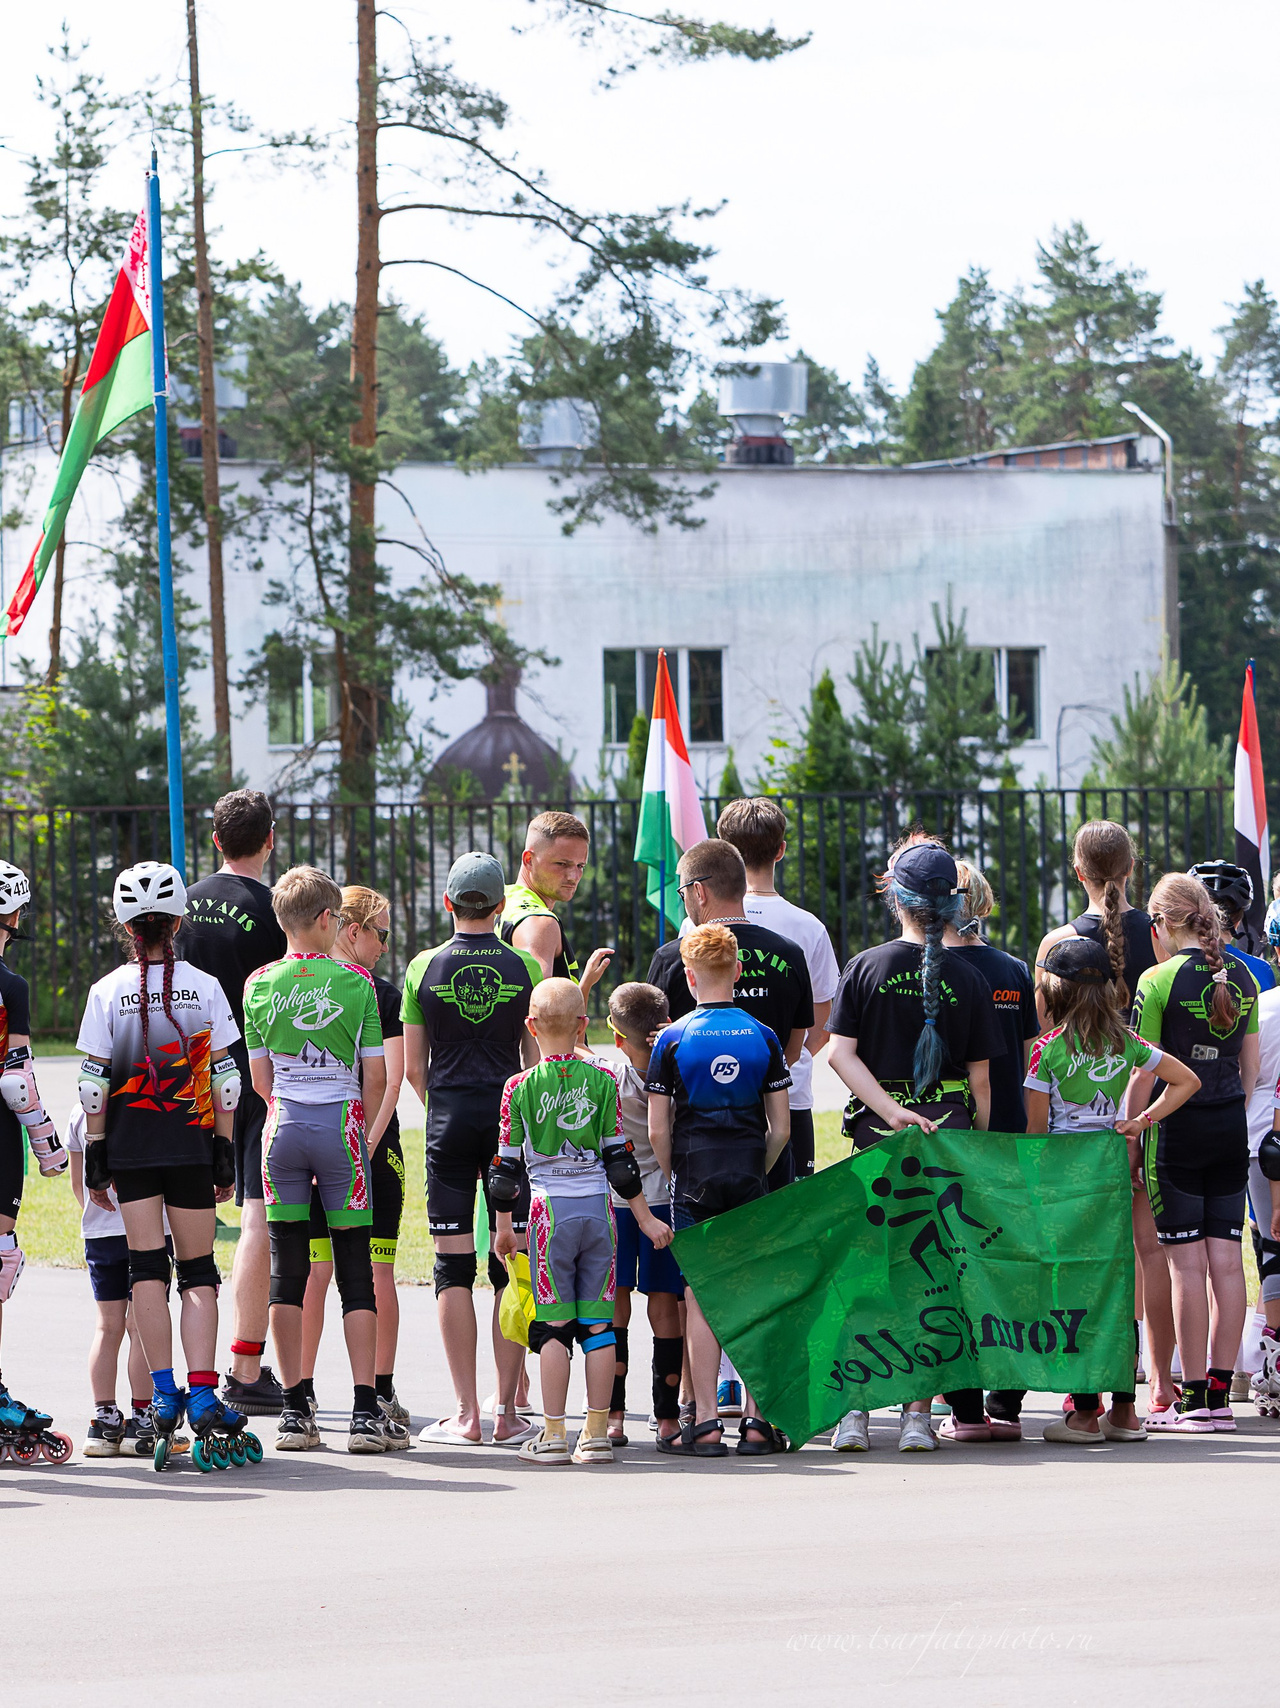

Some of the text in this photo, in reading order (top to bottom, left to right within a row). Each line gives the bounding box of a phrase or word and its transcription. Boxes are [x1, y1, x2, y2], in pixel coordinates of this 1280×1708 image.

[192, 914, 225, 924] ROMAN
[451, 948, 502, 956] BELARUS
[737, 948, 792, 978] OVIK
[1195, 961, 1236, 972] BERUS
[740, 968, 766, 977] MAN
[733, 987, 769, 998] OACH
[993, 989, 1020, 1003] com
[120, 989, 199, 1008] ПОЯОВА
[266, 977, 332, 1026] Soligorsk
[174, 1002, 202, 1011] область
[703, 1029, 721, 1037] LOVE
[731, 1028, 754, 1037] SKATE.
[712, 1062, 738, 1076] PS
[535, 1078, 589, 1124] Soligorsk
[1157, 1229, 1199, 1240] ELAZ
